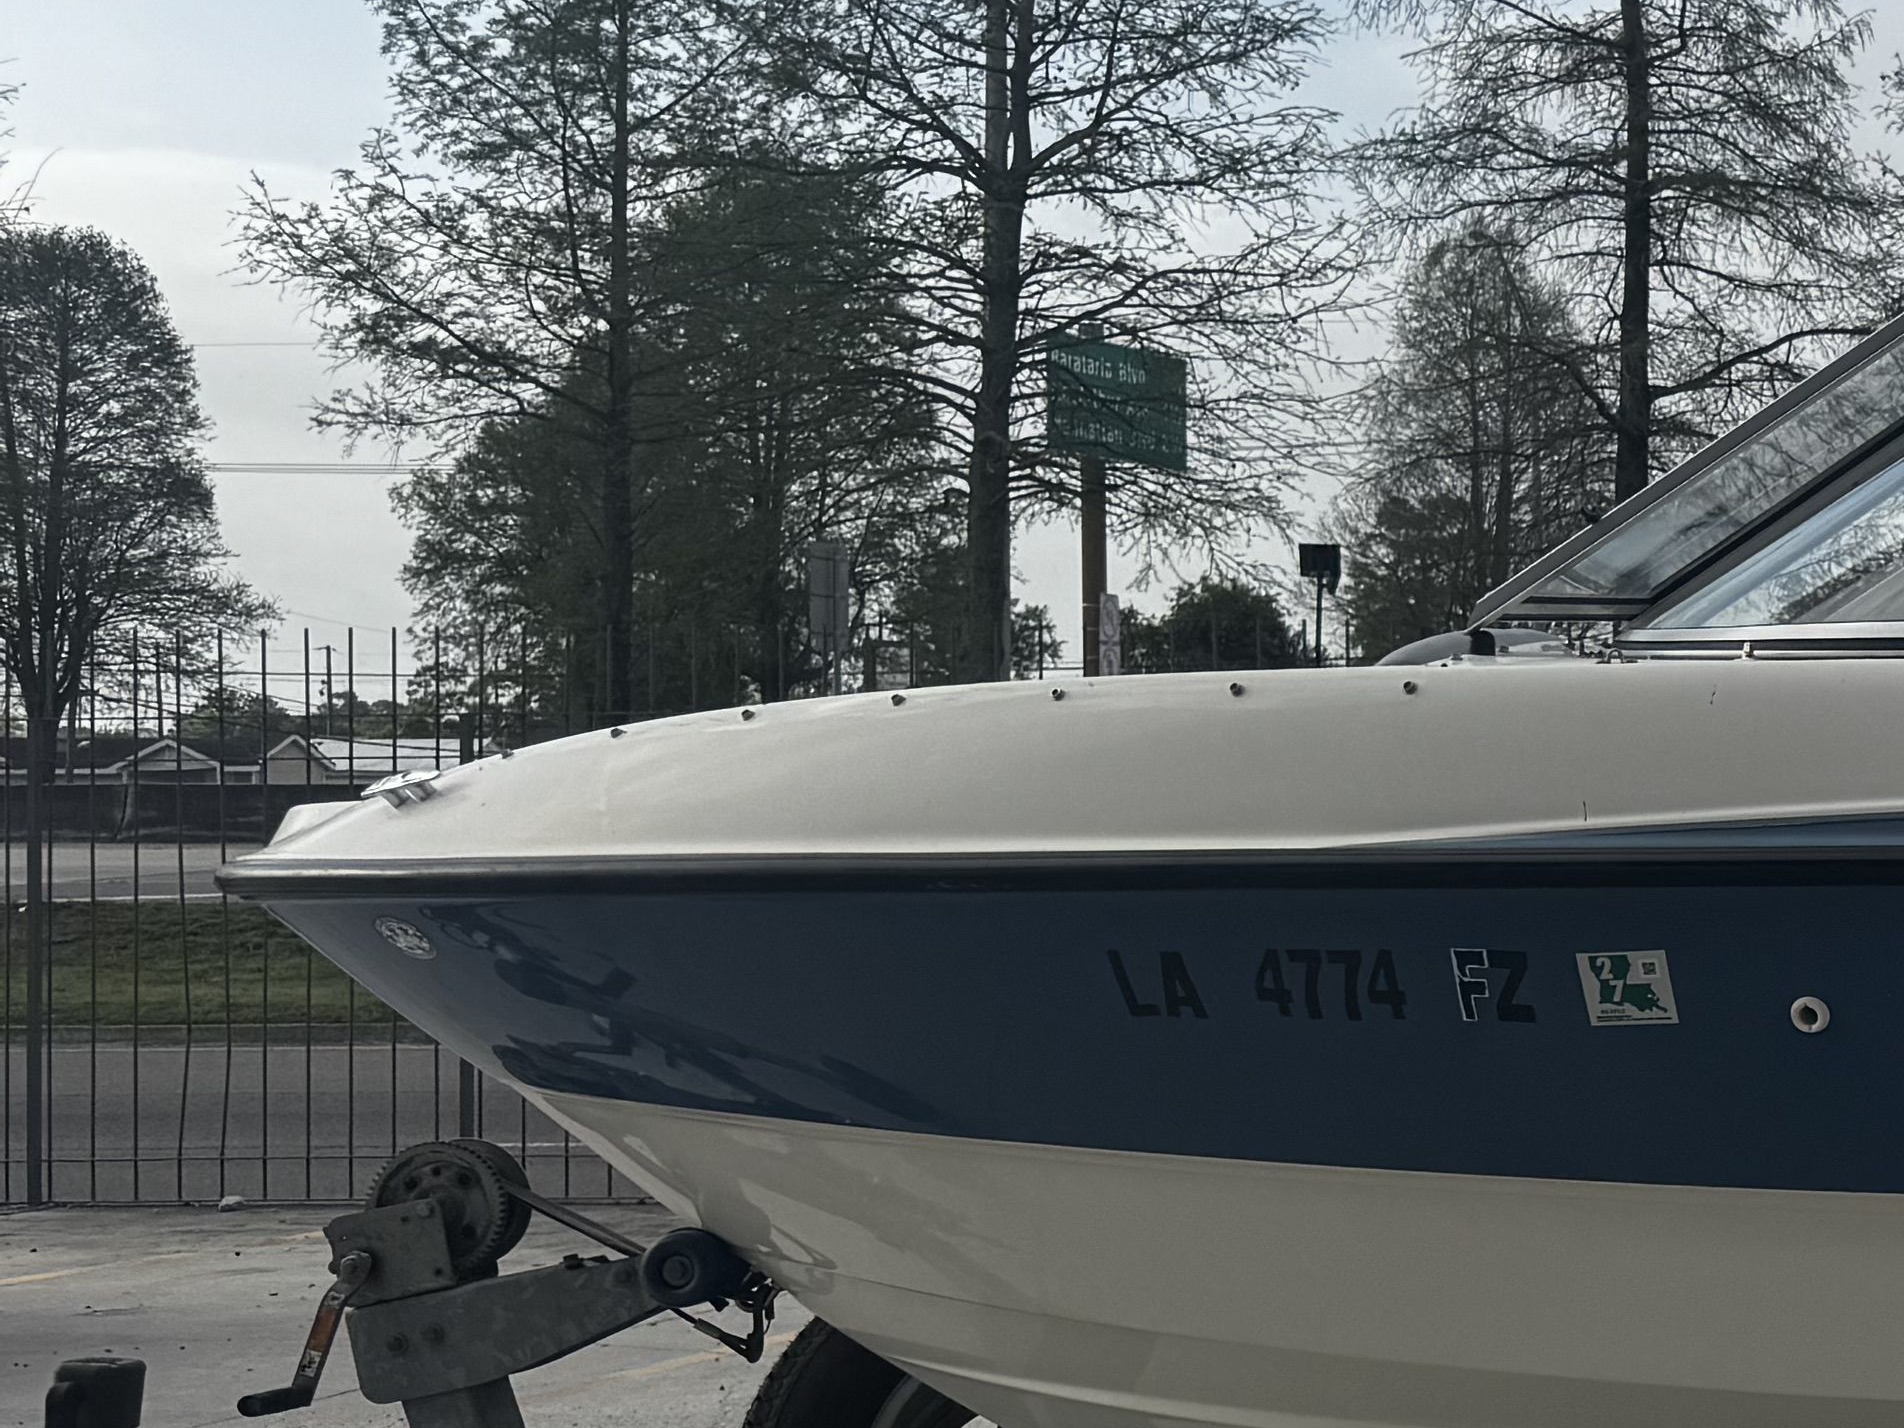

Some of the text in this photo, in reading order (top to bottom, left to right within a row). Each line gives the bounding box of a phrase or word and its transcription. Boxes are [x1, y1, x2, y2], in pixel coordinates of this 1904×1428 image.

[1107, 948, 1536, 1023] LA 4774 FZ
